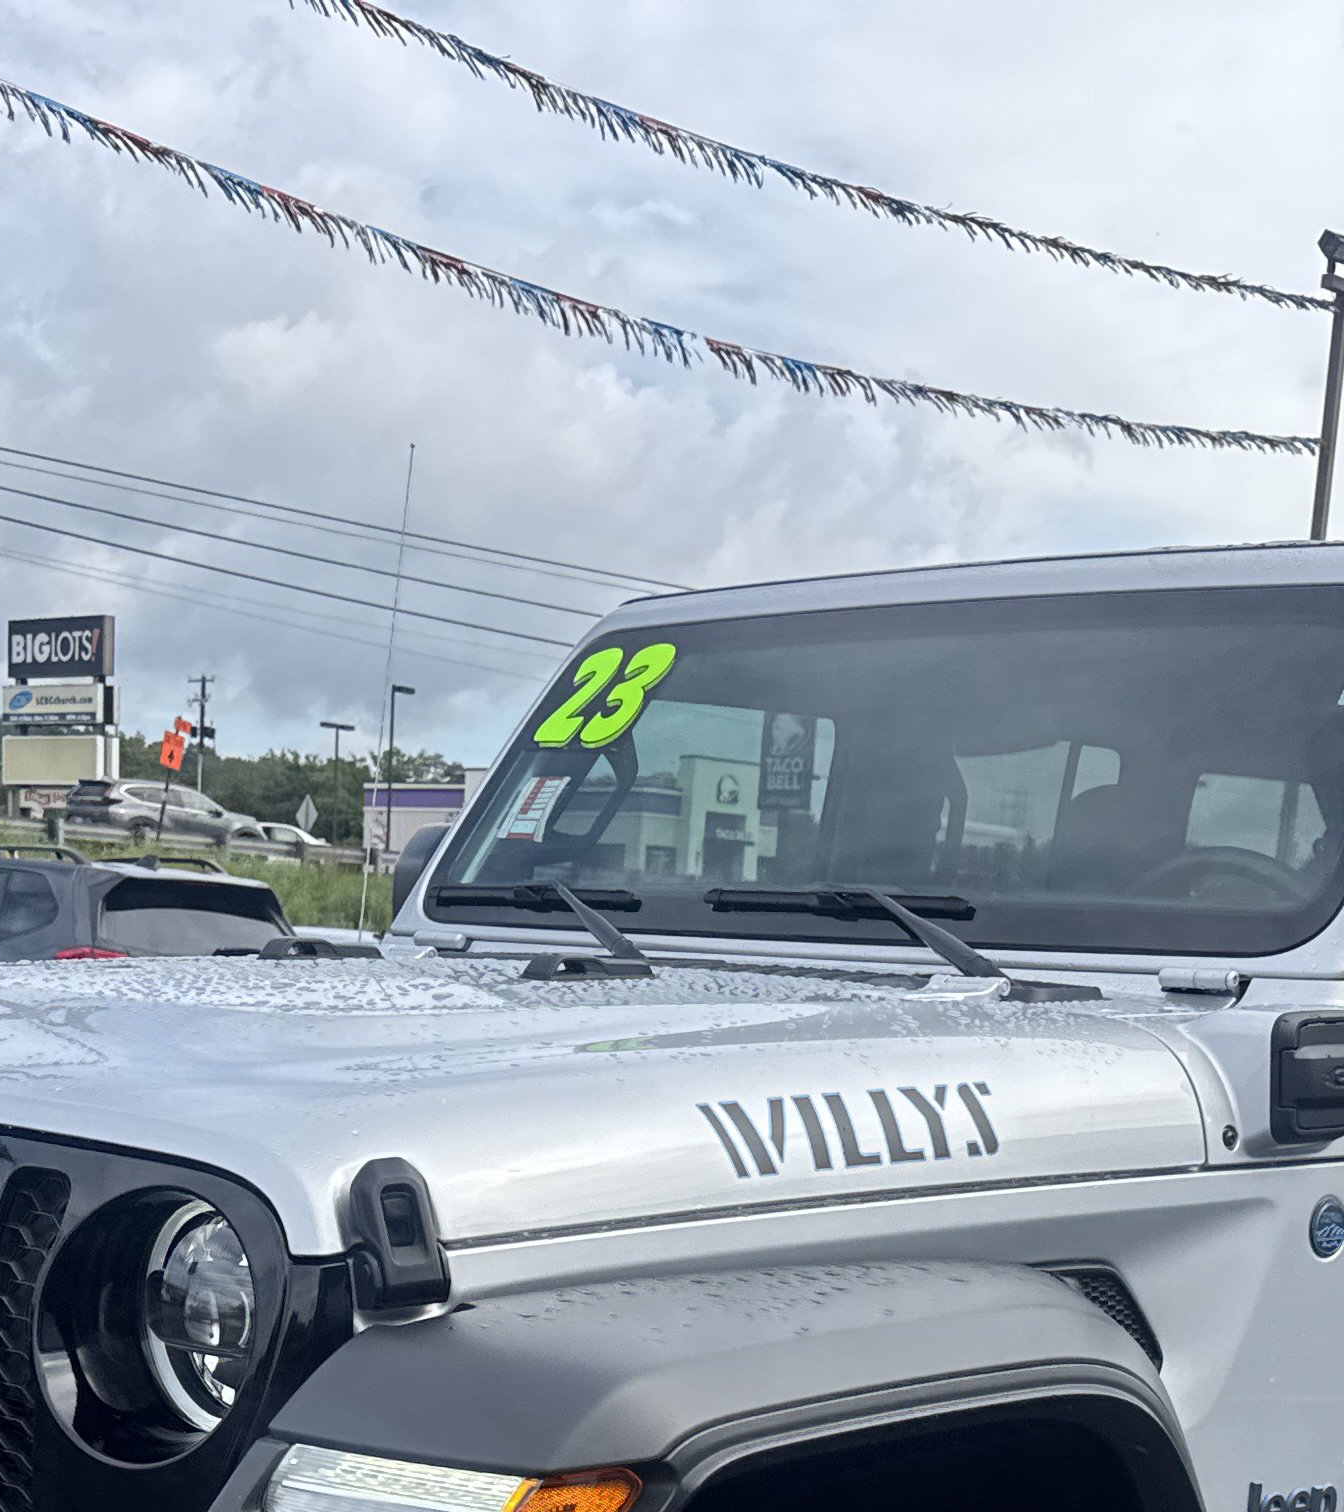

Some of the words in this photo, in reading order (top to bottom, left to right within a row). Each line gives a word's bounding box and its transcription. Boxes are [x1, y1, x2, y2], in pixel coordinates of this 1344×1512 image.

[533, 643, 677, 748] 23
[765, 757, 804, 773] TACO
[766, 774, 801, 790] BELL
[696, 1081, 1000, 1179] WILLYS
